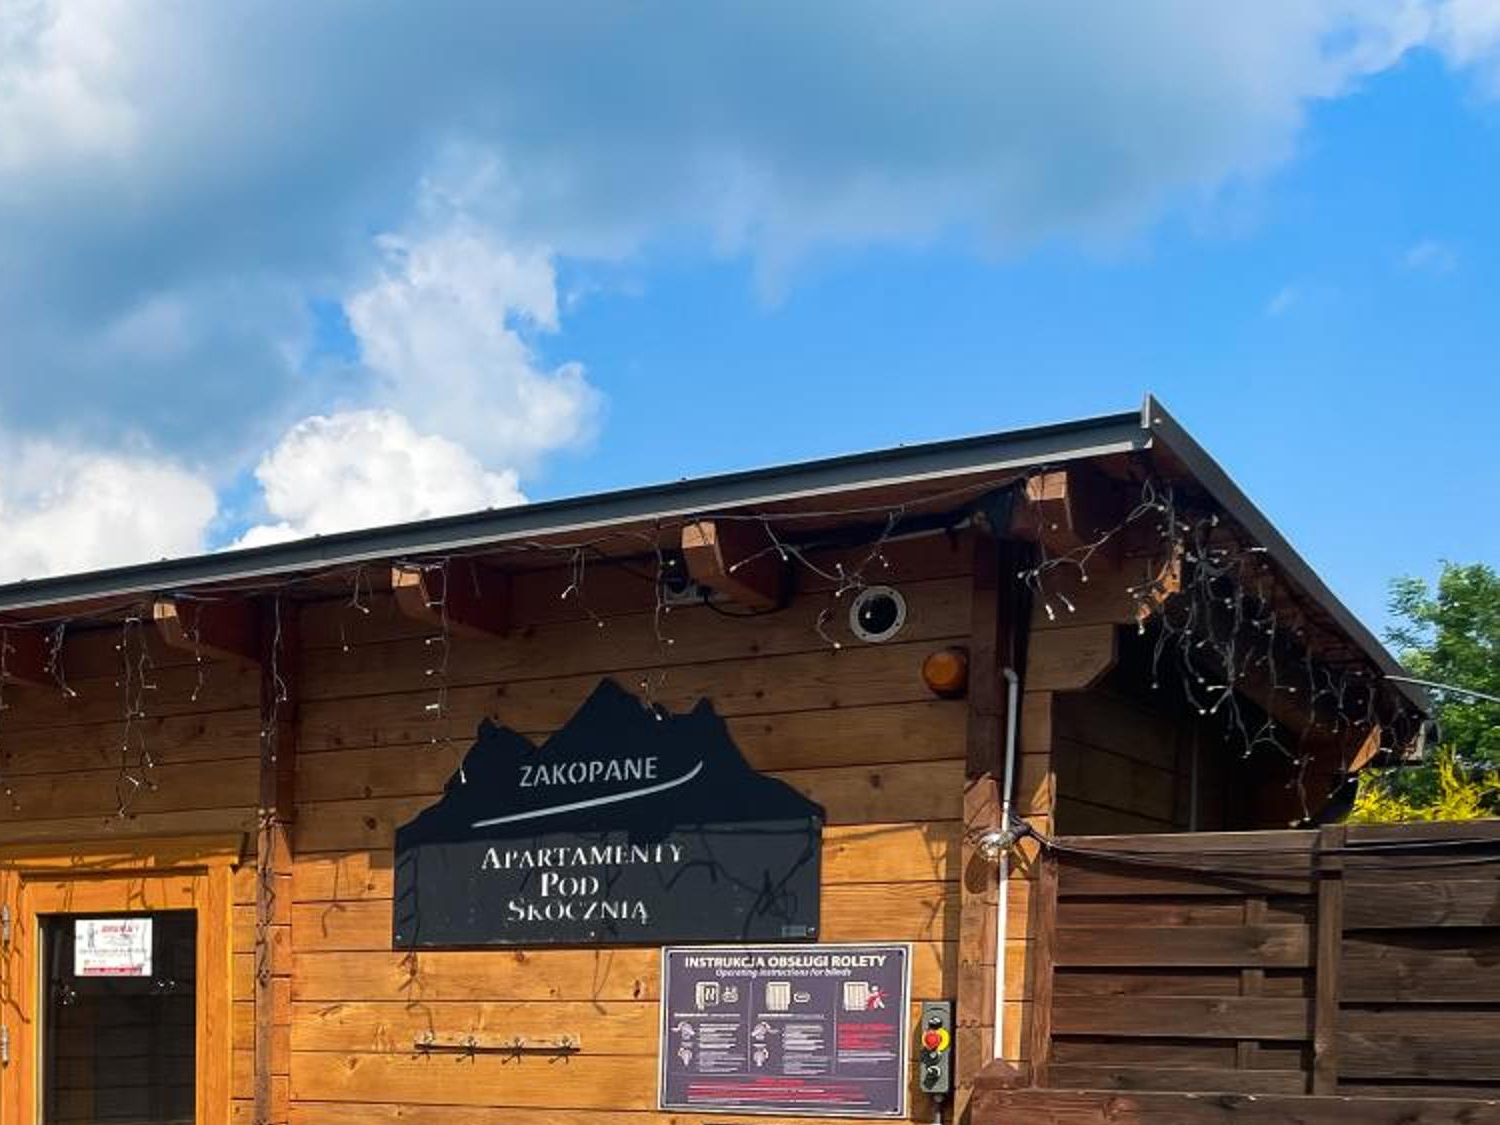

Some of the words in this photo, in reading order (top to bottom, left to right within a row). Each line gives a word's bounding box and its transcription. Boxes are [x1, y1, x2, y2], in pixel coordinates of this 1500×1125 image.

[519, 756, 658, 788] ZAKOPANE
[684, 955, 765, 969] INSTRUKCJA
[767, 955, 828, 968] OBSŁUGI
[831, 955, 886, 967] ROLETY
